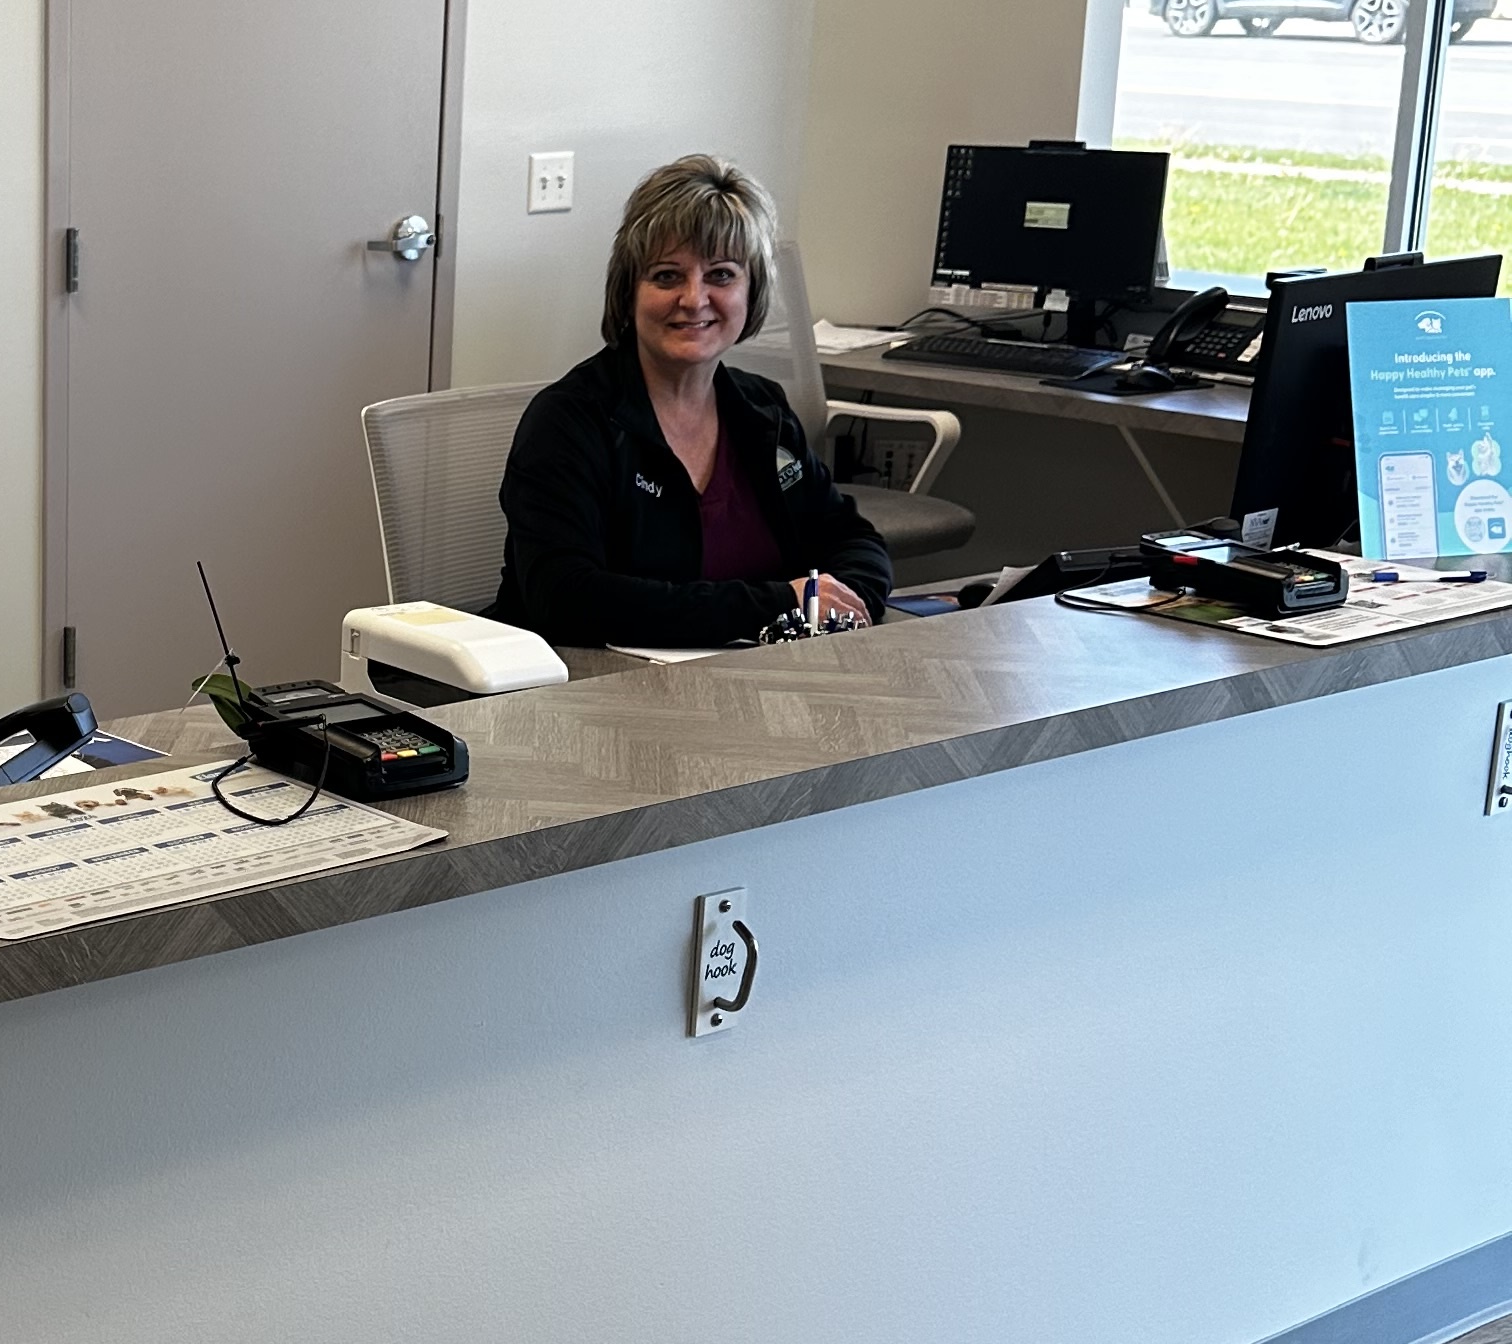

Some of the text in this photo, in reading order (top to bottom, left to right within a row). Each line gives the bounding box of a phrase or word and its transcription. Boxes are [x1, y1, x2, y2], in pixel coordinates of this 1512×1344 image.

[1291, 304, 1333, 324] Lenovo
[1394, 350, 1472, 364] Introducing the
[1370, 369, 1405, 382] Happy
[1406, 367, 1446, 381] Healthy
[1473, 367, 1497, 379] app.
[635, 472, 663, 498] Cindy
[710, 939, 736, 960] dog
[704, 958, 738, 982] hook
